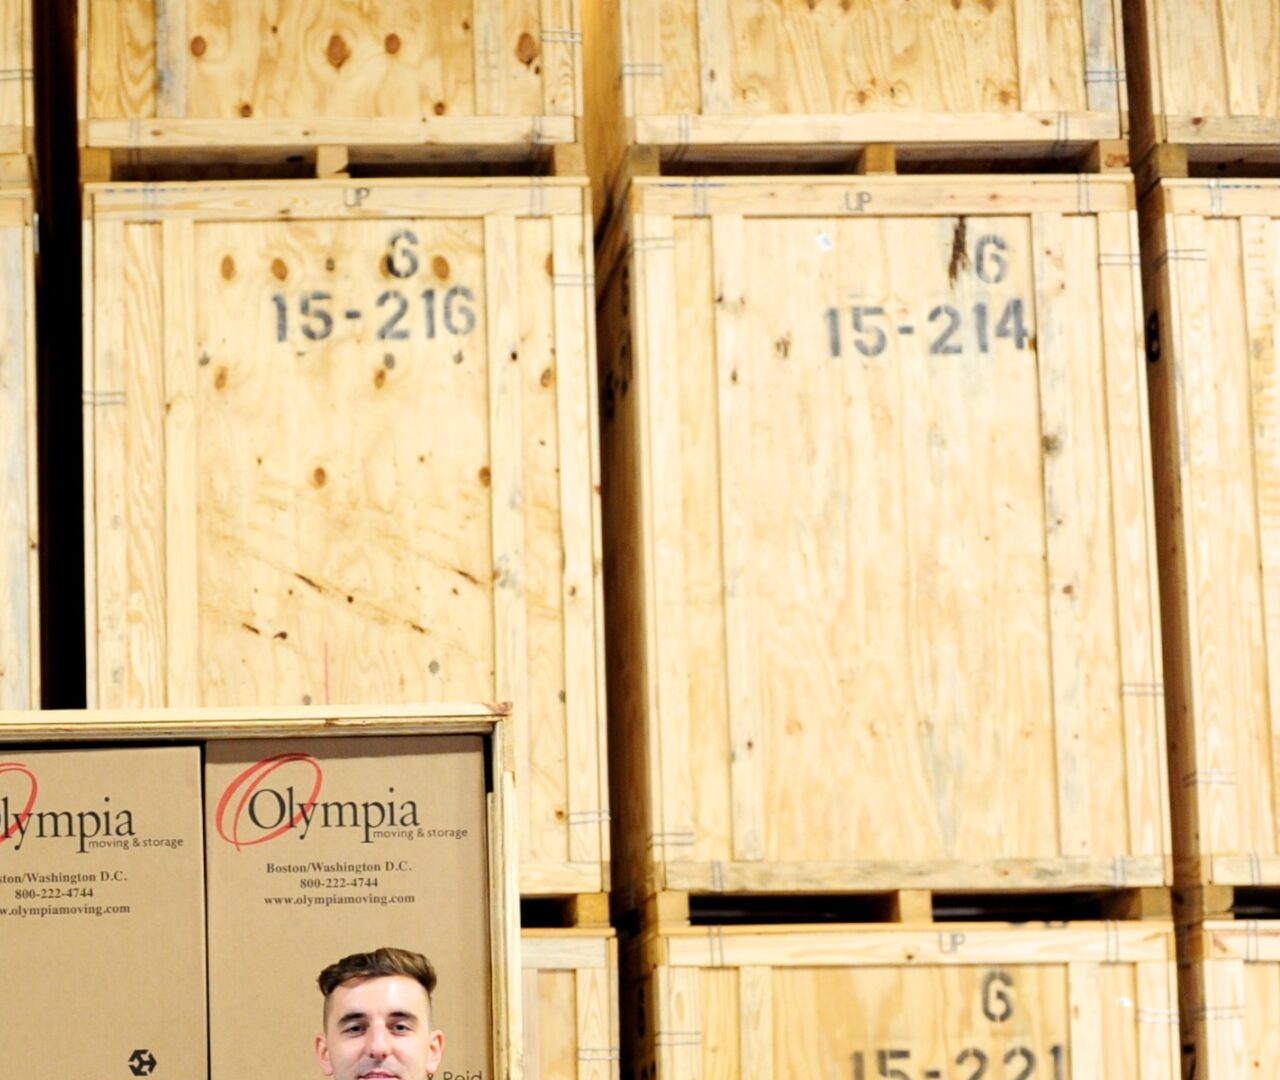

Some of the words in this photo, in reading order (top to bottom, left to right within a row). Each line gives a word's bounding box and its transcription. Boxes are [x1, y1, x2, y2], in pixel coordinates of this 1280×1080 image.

[387, 229, 418, 279] 6
[975, 234, 1008, 284] 6
[272, 286, 476, 342] 15-216
[826, 297, 1029, 357] 15-214
[248, 786, 421, 843] Olympia
[373, 828, 414, 840] moving
[417, 828, 425, 838] &
[428, 828, 468, 840] storage
[88, 837, 129, 850] moving
[132, 837, 141, 848] &
[142, 837, 184, 849] storage
[266, 861, 381, 874] Boston/Washington
[385, 861, 412, 872] D.C.
[100, 871, 128, 882] D.C.
[300, 878, 379, 889] 800-222-4744
[14, 888, 94, 899] 800-222-4744
[264, 894, 415, 907] www.olympiamoving.com
[982, 970, 1014, 1023] 6
